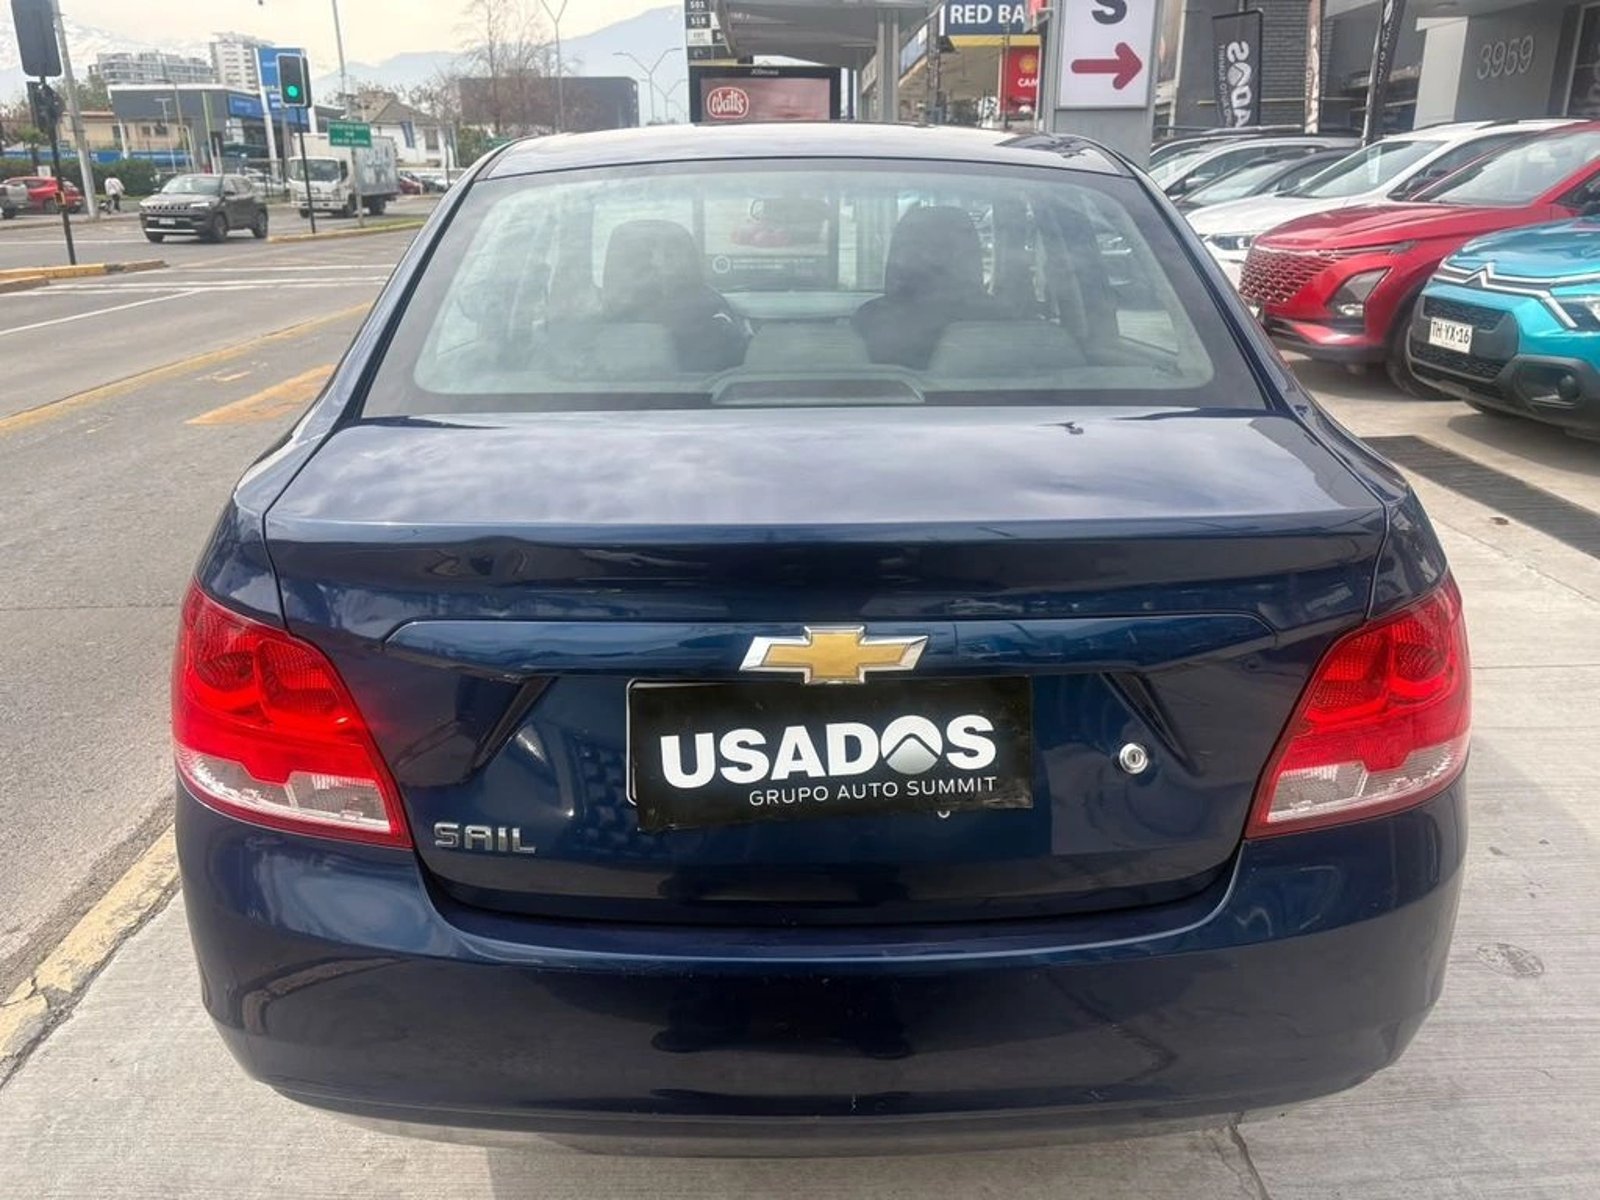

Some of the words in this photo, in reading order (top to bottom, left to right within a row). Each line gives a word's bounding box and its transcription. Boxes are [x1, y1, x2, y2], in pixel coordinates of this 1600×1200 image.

[950, 5, 993, 24] RED
[1477, 35, 1534, 80] 3959
[660, 714, 996, 789] USADOS
[749, 785, 830, 806] GRUPO
[836, 781, 899, 801] AUTO
[906, 775, 998, 797] SUMMIT
[433, 822, 537, 854] SAIL
